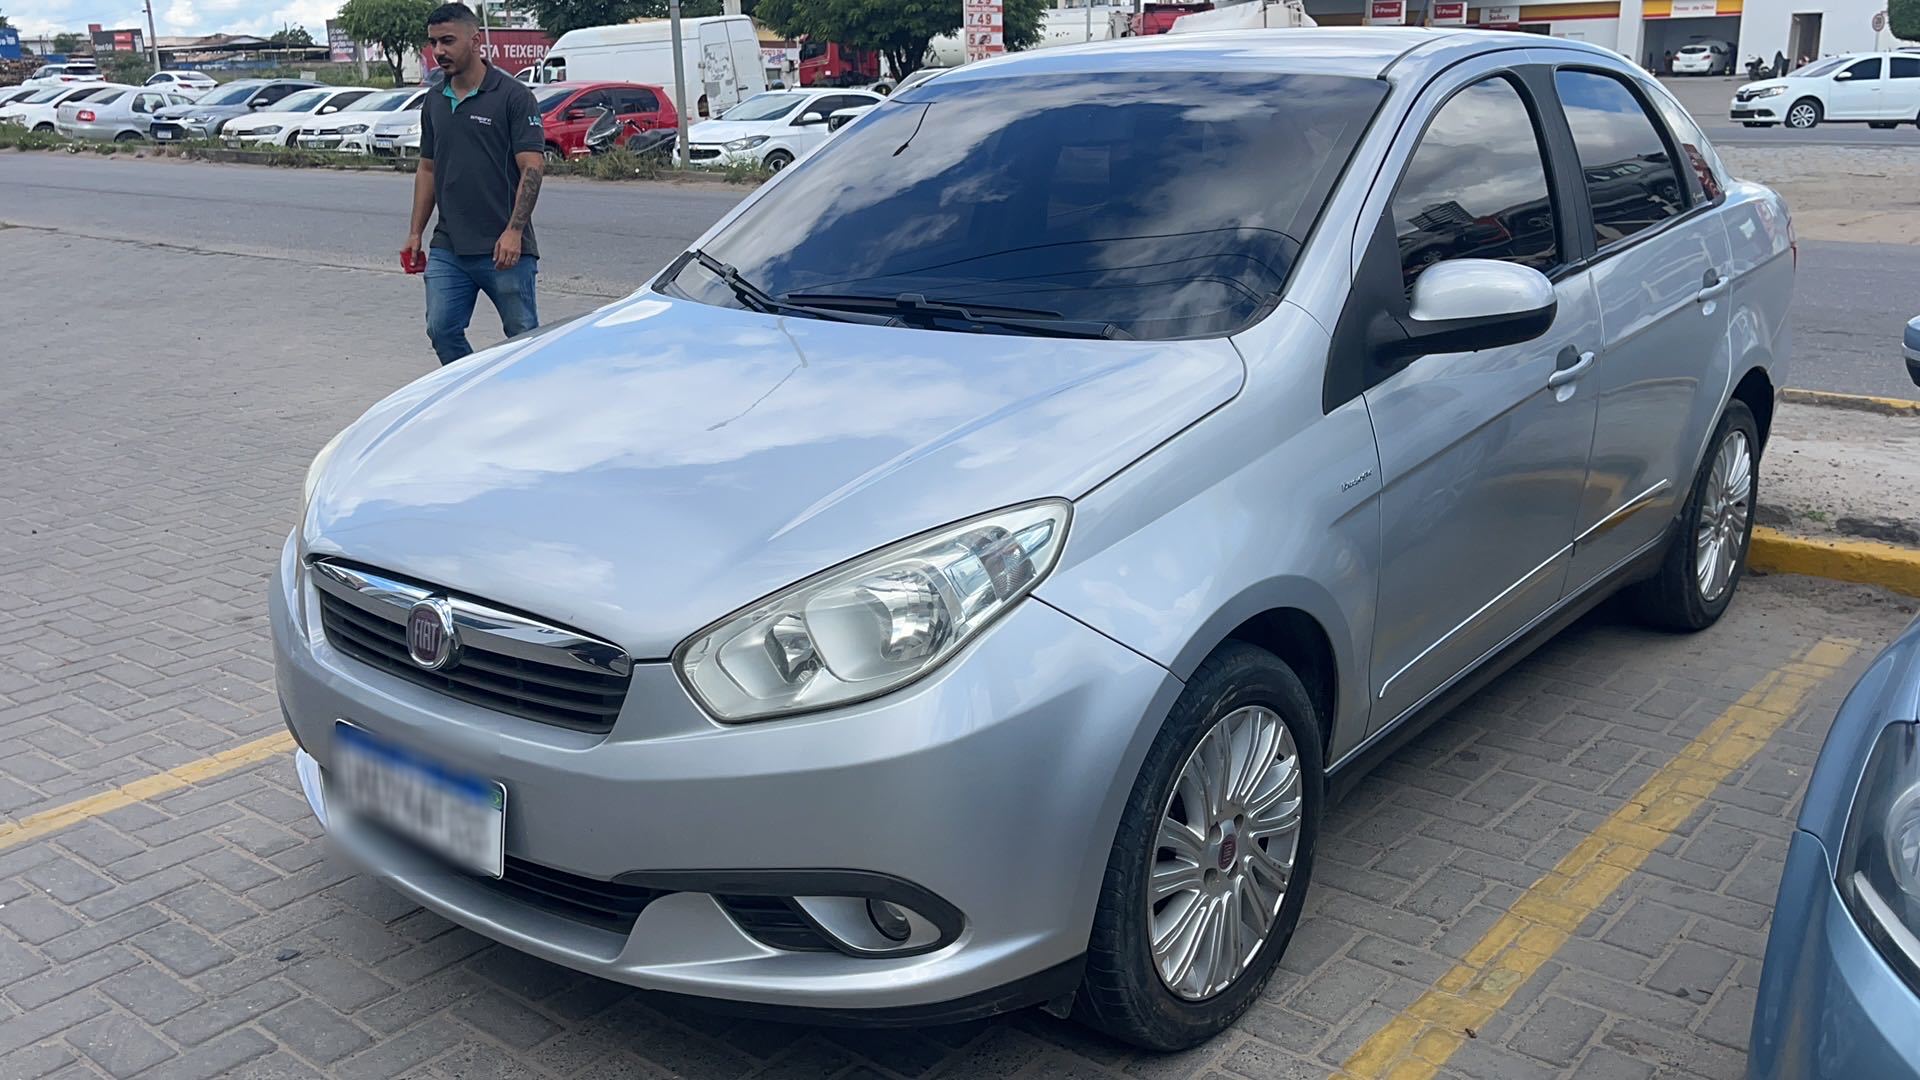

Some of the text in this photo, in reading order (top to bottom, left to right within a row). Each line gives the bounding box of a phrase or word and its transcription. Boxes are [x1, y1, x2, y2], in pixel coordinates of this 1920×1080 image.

[969, 14, 992, 25] 749
[480, 45, 499, 58] STA
[415, 618, 439, 652] FIAT
